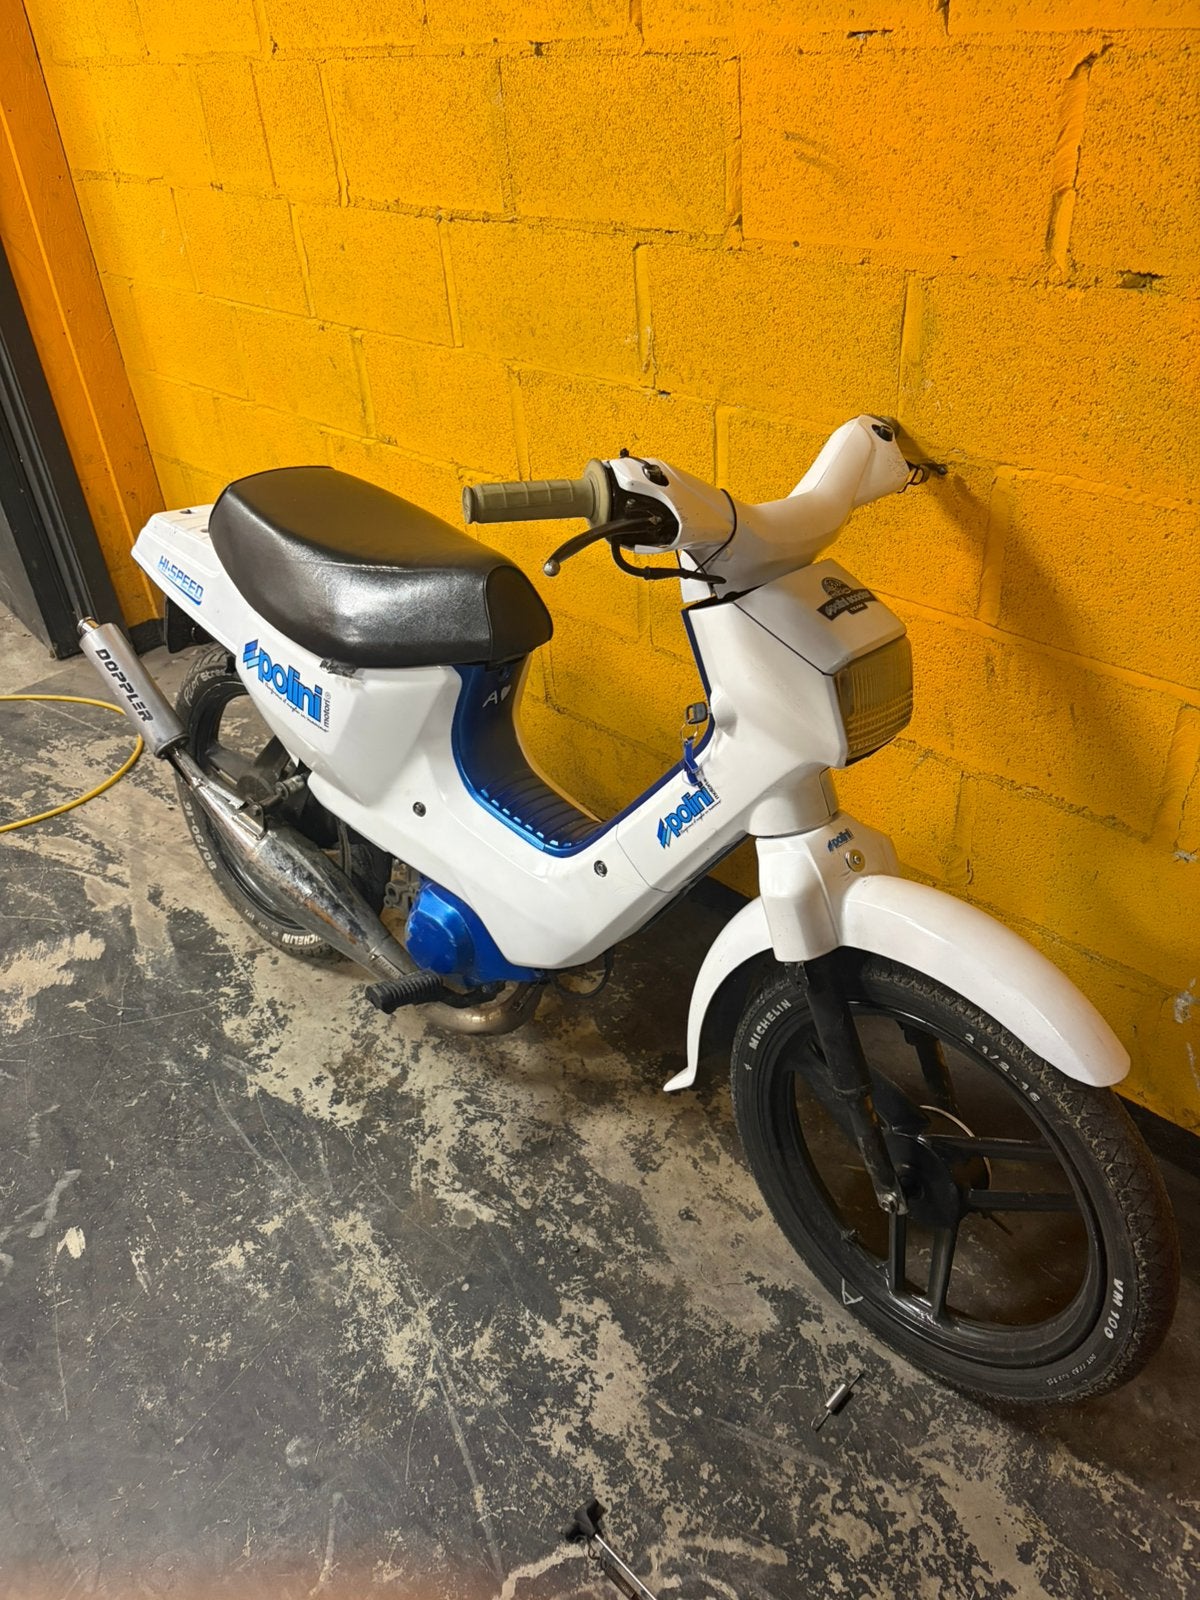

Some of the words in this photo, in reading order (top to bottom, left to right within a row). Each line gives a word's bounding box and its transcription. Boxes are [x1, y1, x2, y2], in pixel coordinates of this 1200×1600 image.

[95, 648, 154, 723] DOPPLER
[257, 647, 323, 723] polini
[323, 699, 332, 728] motori
[665, 781, 716, 838] polini
[281, 932, 321, 946] ICHELIN
[748, 998, 792, 1050] MICHELIN
[964, 1033, 975, 1045] 2
[1104, 1310, 1120, 1339] 100
